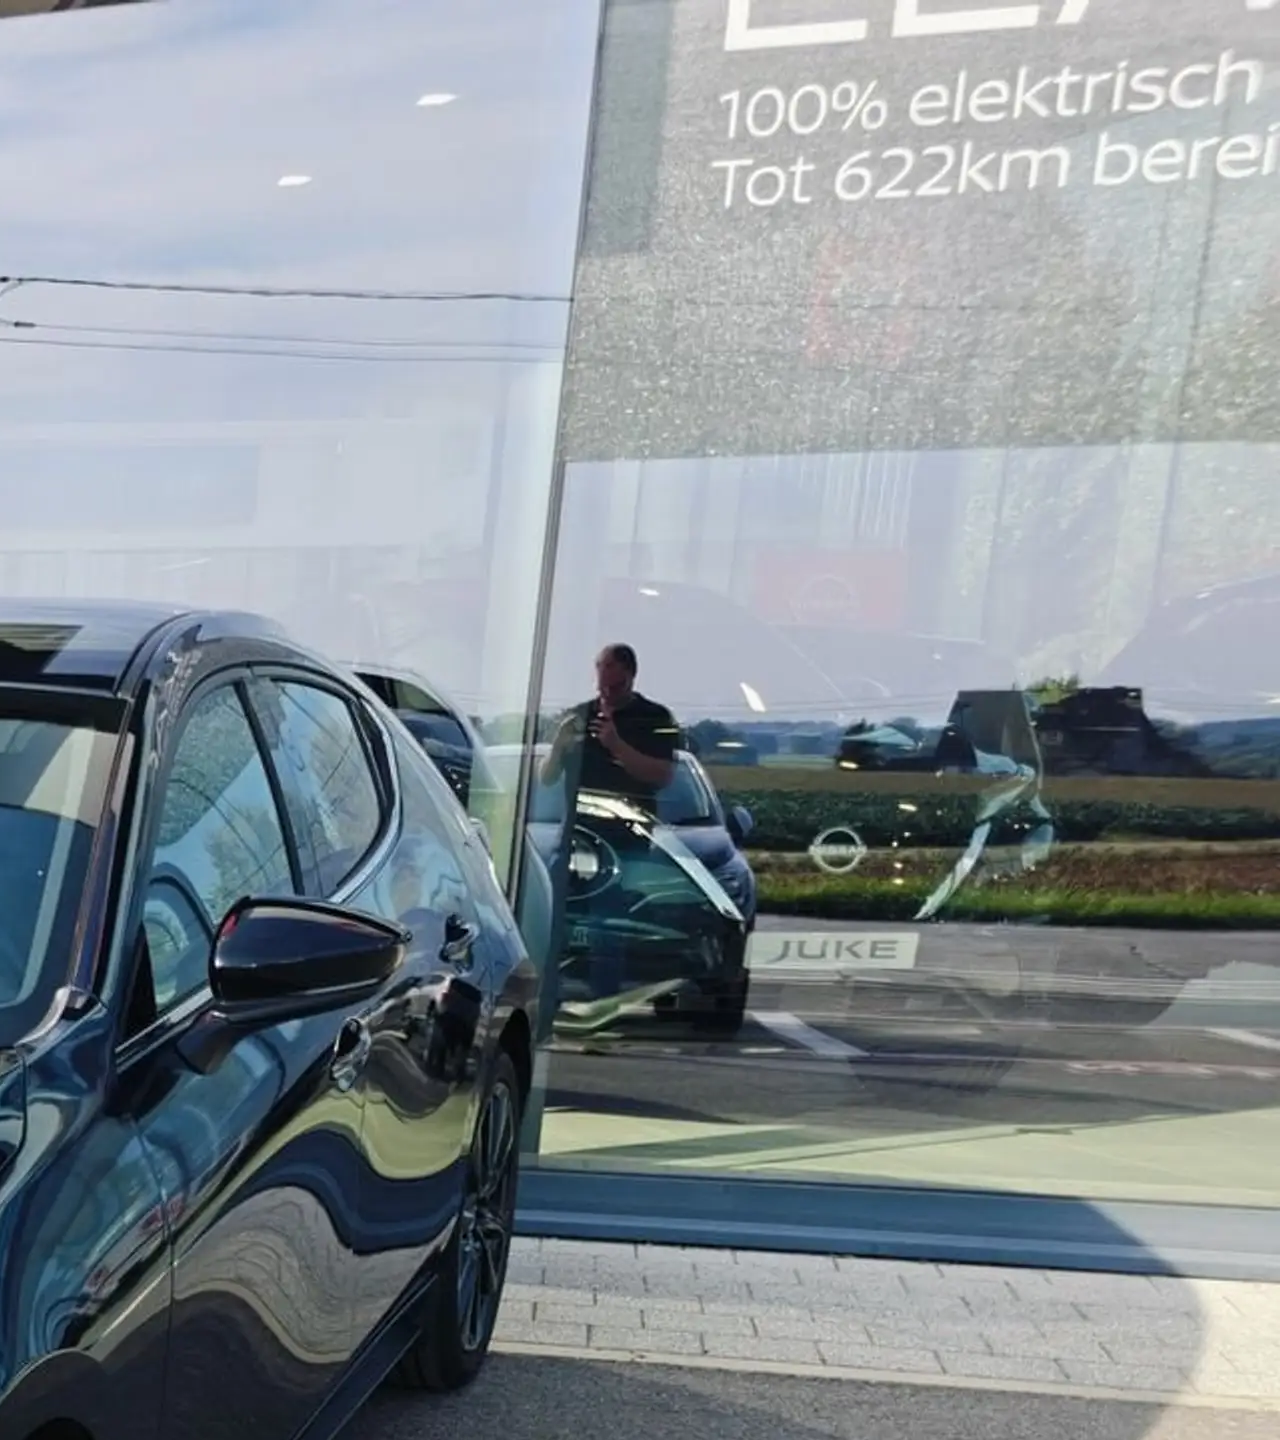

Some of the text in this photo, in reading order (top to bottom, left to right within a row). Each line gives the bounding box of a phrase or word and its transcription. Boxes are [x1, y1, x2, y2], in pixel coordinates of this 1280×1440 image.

[719, 48, 1264, 139] 100% elektrisch
[711, 156, 817, 209] Tot
[834, 140, 1072, 201] 622km
[765, 939, 900, 965] JUKE
